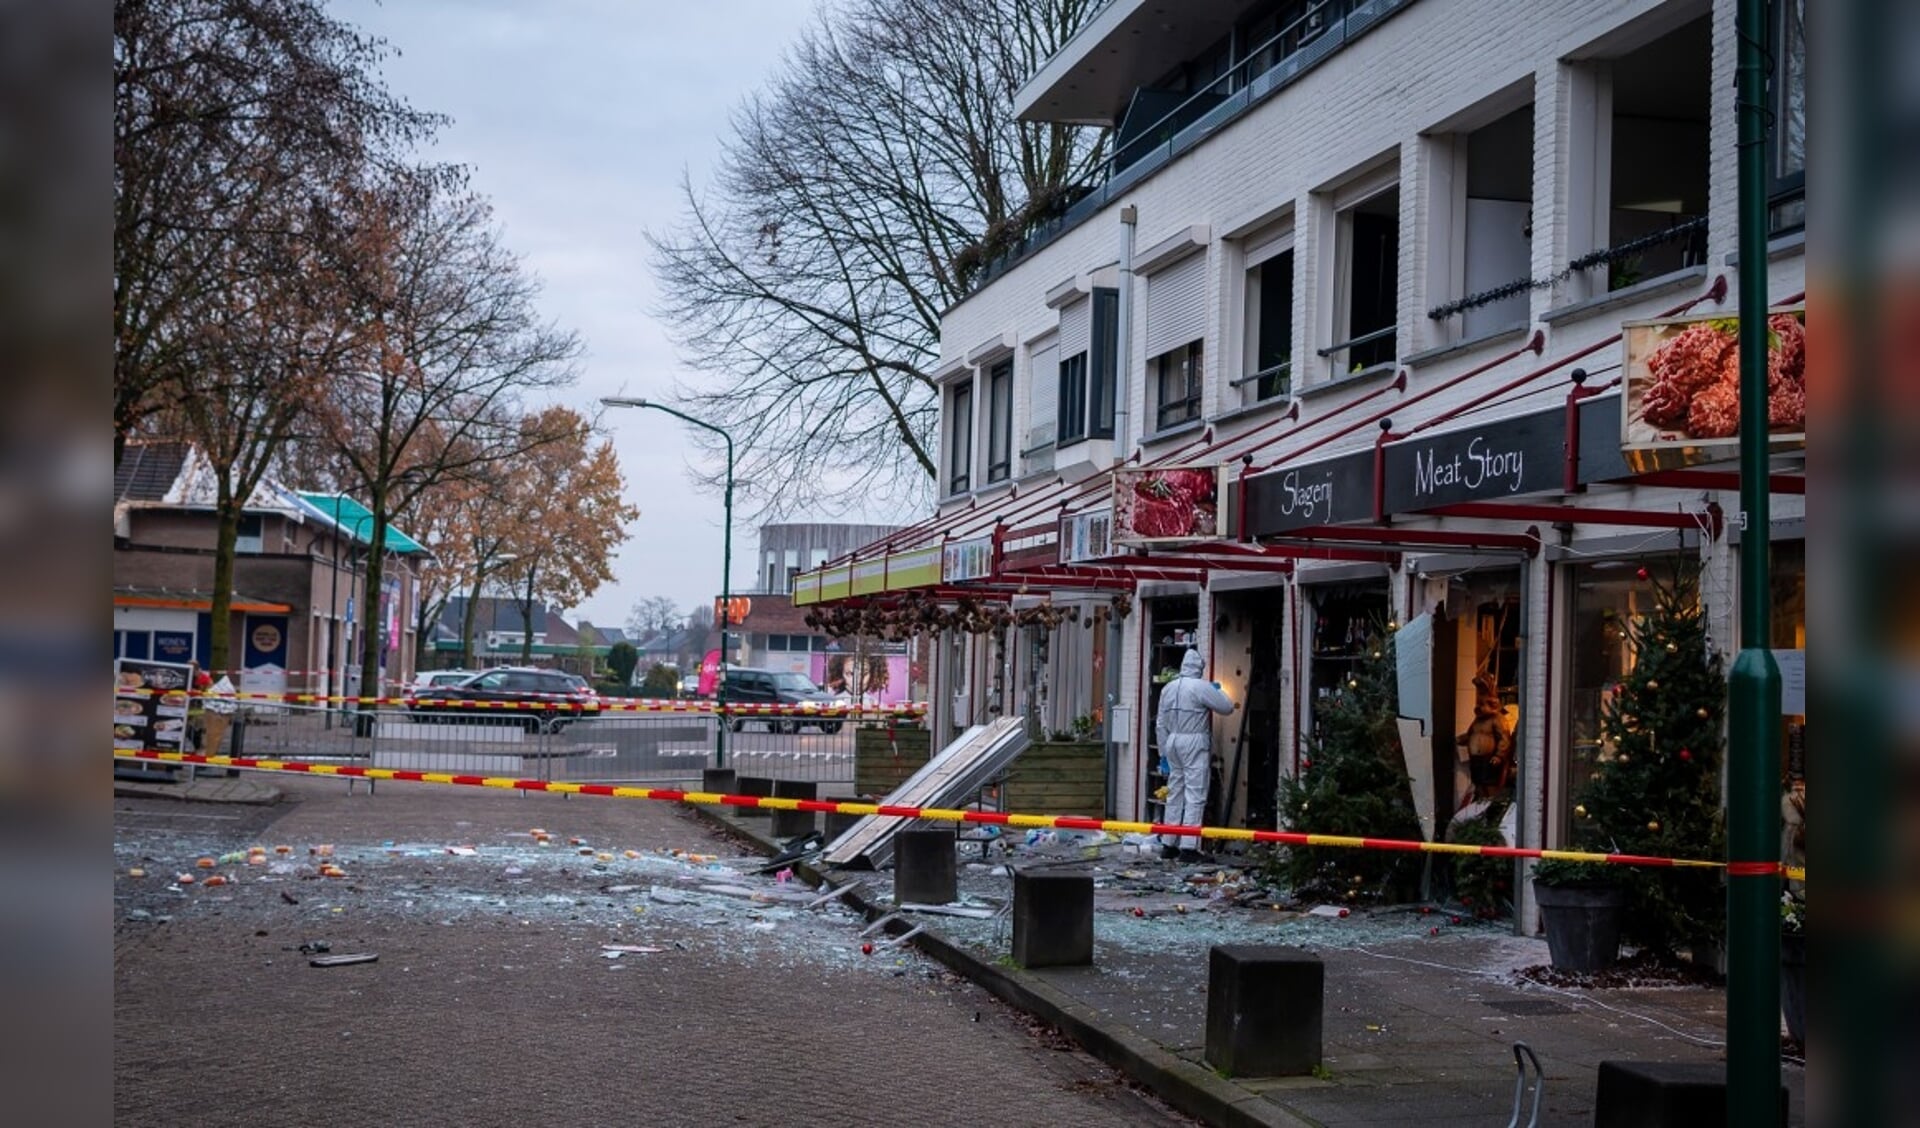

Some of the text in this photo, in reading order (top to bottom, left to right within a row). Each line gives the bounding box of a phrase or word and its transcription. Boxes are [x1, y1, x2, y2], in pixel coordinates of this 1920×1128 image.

[1415, 436, 1523, 497] Meat Story
[1281, 470, 1333, 525] Slagerij
